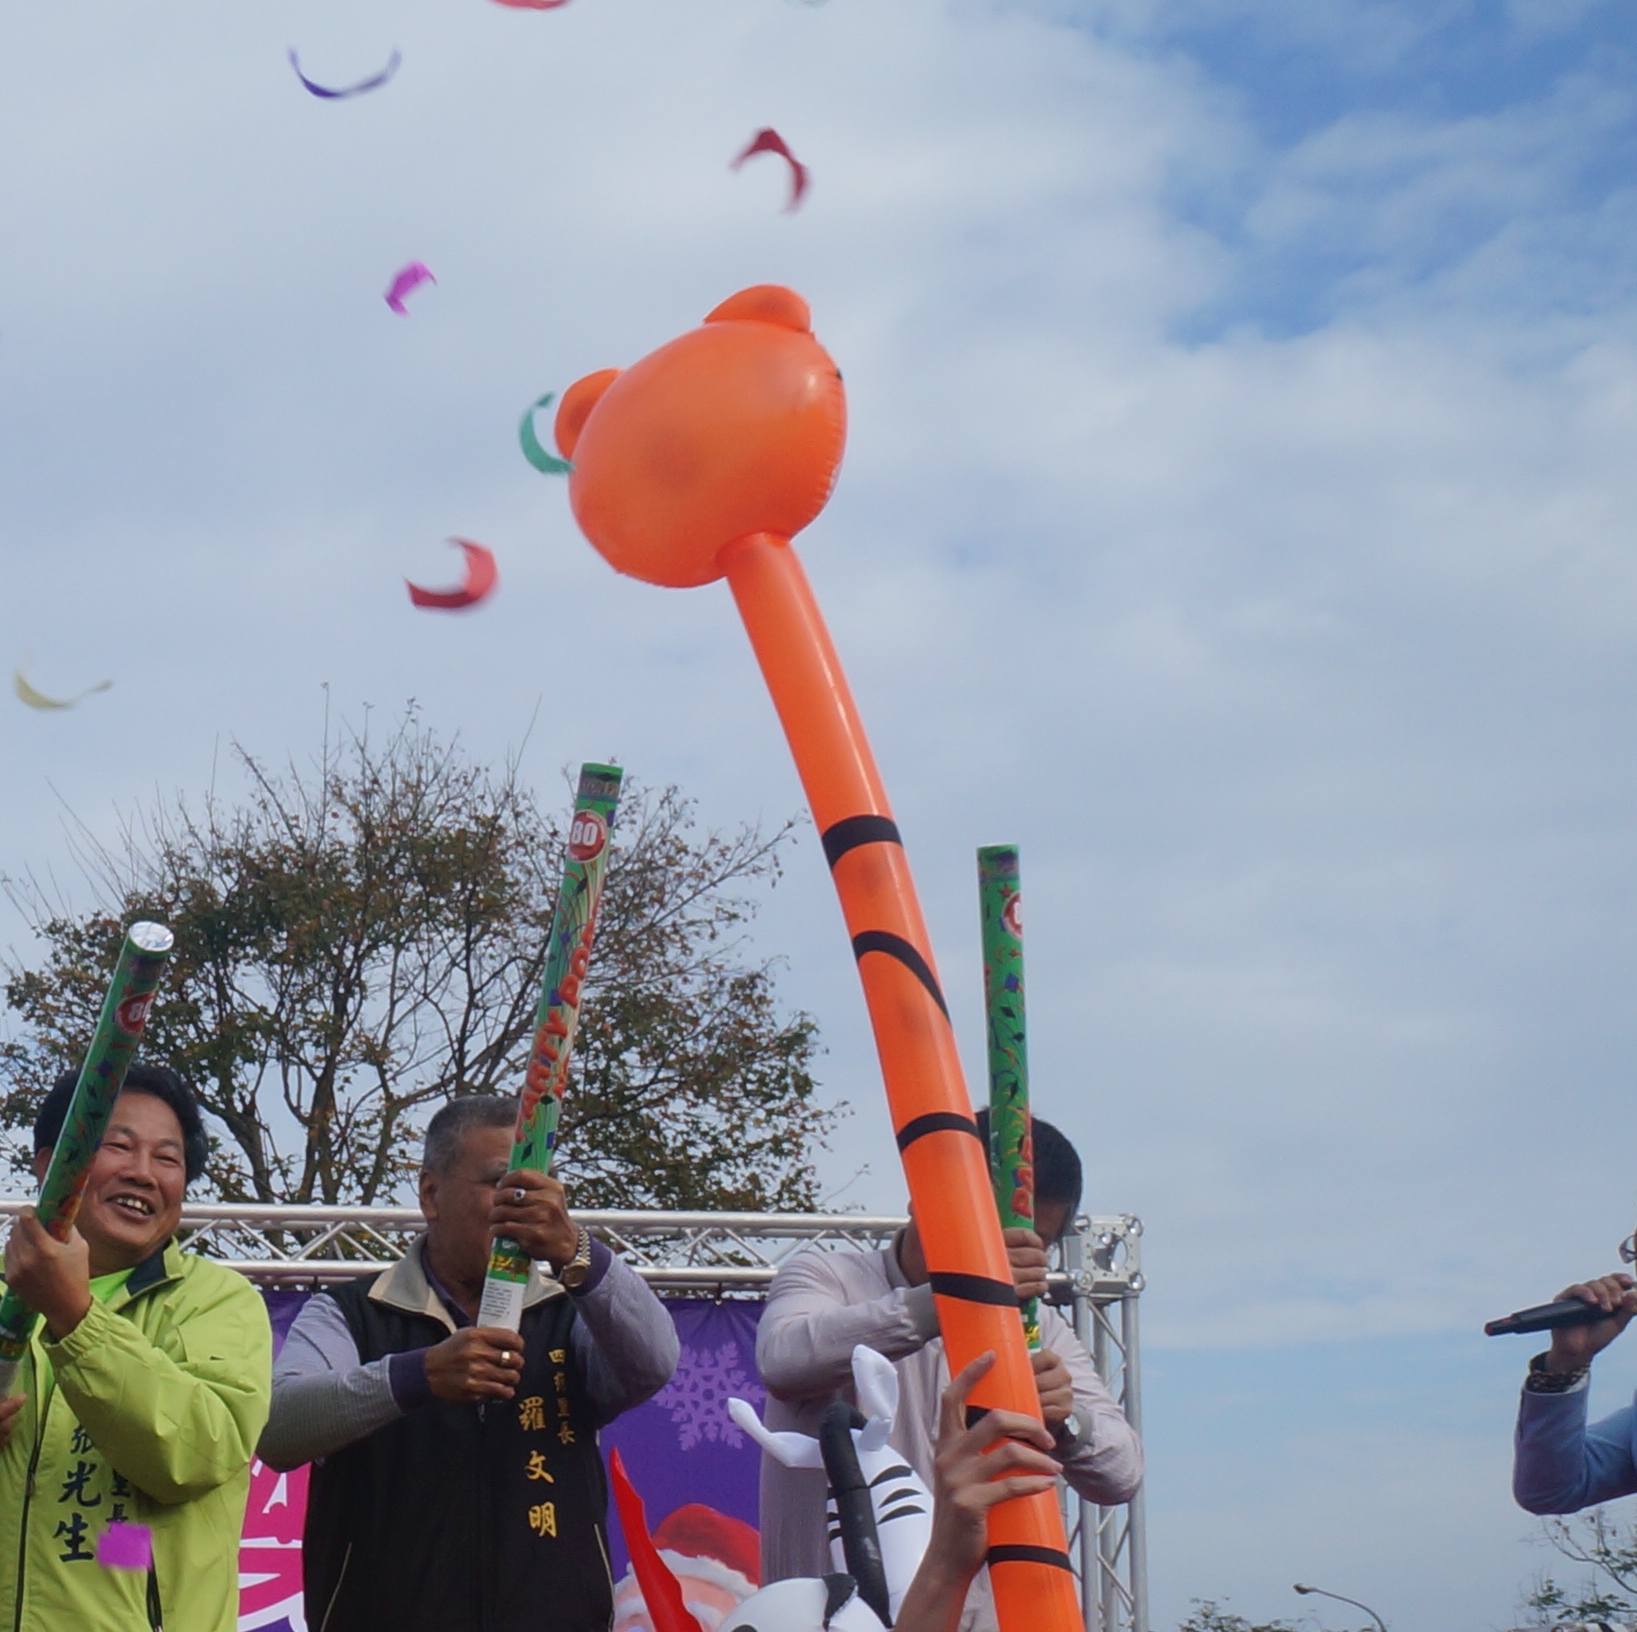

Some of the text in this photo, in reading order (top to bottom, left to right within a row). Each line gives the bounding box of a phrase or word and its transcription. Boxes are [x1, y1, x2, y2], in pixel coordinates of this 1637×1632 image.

[571, 819, 598, 847] 80
[518, 1396, 556, 1537] 羅文明
